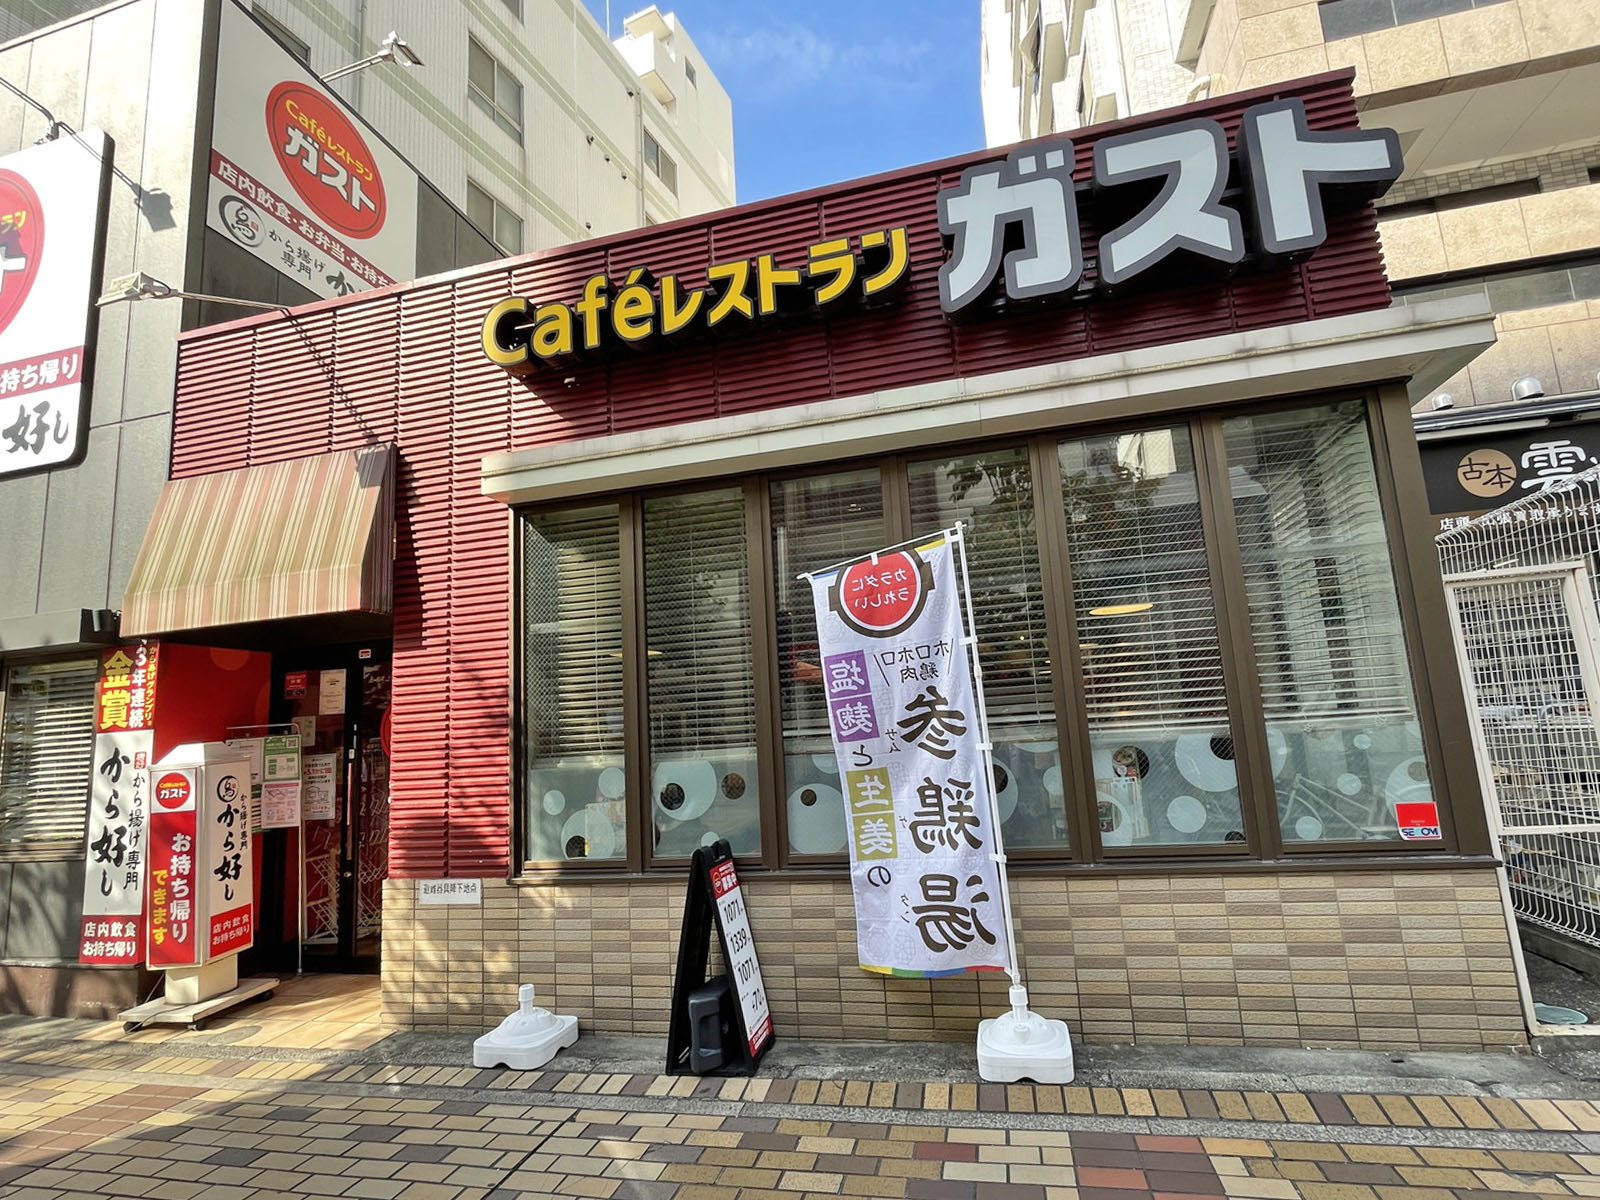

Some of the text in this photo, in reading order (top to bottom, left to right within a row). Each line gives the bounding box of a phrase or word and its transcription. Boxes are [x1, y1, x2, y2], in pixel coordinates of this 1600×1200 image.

[285, 99, 374, 182] Caféレストラン
[285, 124, 376, 213] ガスト
[938, 98, 1401, 314] ガスト
[281, 250, 312, 281] 専門
[481, 226, 909, 364] Caféレストラン
[1459, 457, 1516, 489] 古本
[1521, 439, 1600, 492] 雲
[100, 650, 134, 730] 金賞
[91, 747, 130, 897] から好し
[160, 788, 188, 799] ガスト
[123, 772, 146, 891] から揚げ専門
[214, 804, 243, 901] から好し
[1401, 827, 1439, 836] SECOM
[153, 869, 168, 945] できます
[170, 832, 192, 943] お持ち帰り
[724, 899, 742, 924] 1071
[82, 941, 136, 957] お持ち帰り
[84, 921, 136, 938] 店内飲食
[730, 928, 748, 955] 1339
[738, 957, 755, 984] 1071
